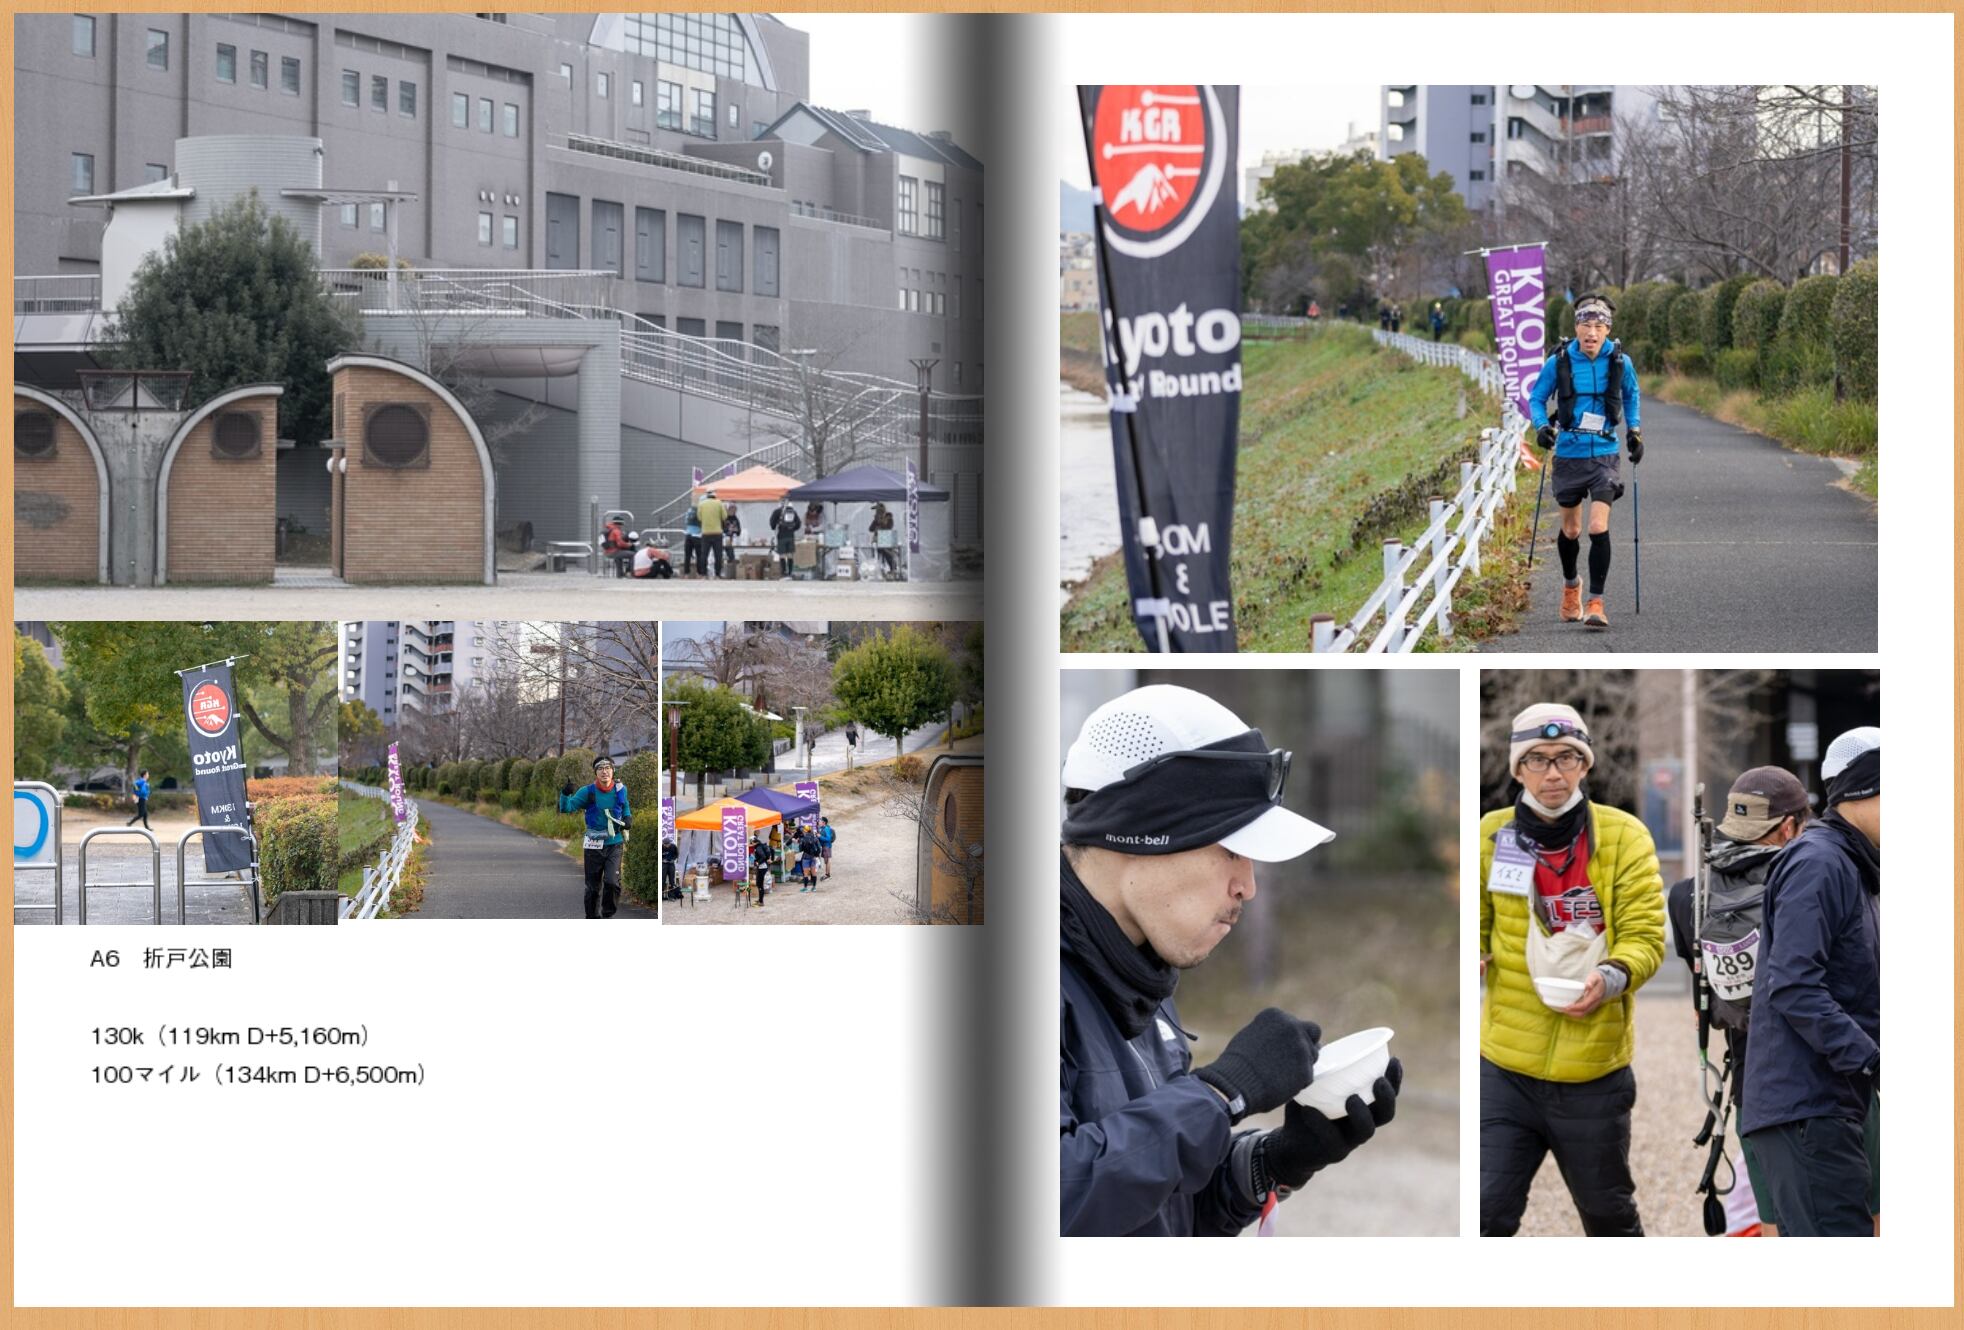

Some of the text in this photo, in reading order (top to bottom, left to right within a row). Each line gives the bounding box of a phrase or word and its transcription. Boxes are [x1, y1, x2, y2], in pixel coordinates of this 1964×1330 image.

[1120, 107, 1181, 142] KGR
[1494, 269, 1514, 329] GREAT
[1149, 362, 1243, 398] Round
[1712, 951, 1755, 976] 289
